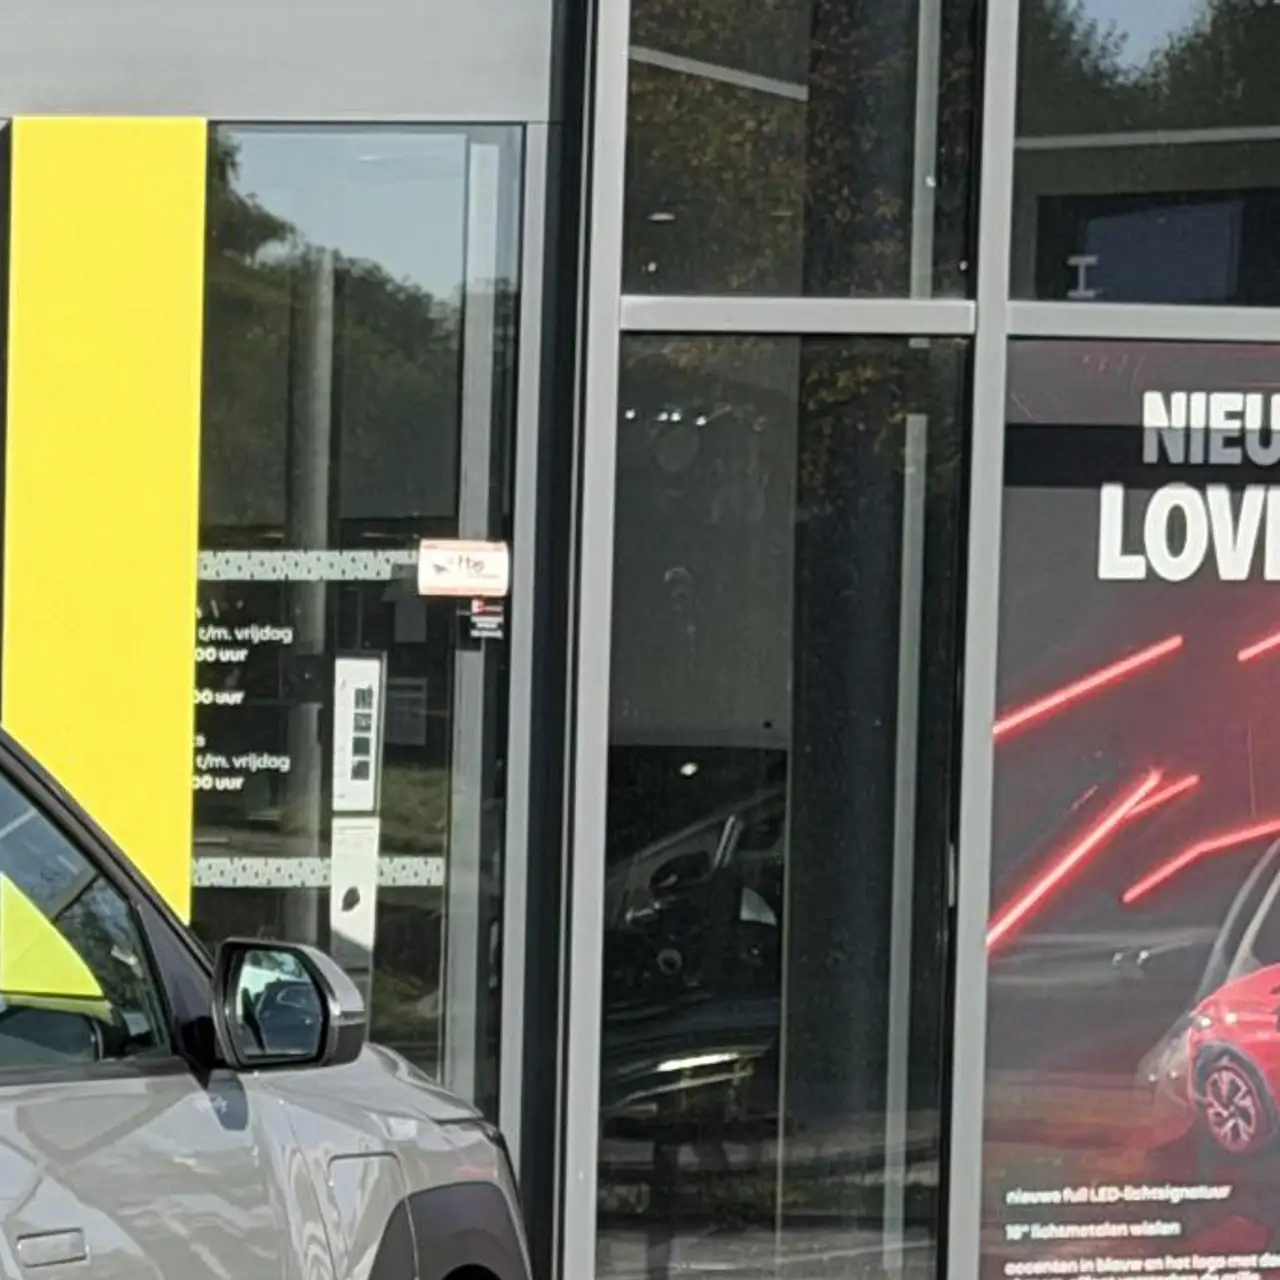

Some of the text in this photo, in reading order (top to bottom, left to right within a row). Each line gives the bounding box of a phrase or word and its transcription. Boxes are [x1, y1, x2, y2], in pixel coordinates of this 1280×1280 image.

[1142, 391, 1280, 466] NIEU
[234, 624, 293, 645] vrijdag
[219, 647, 249, 662] uur
[215, 690, 246, 705] uur
[232, 752, 291, 773] vrijdag
[215, 777, 245, 790] uur
